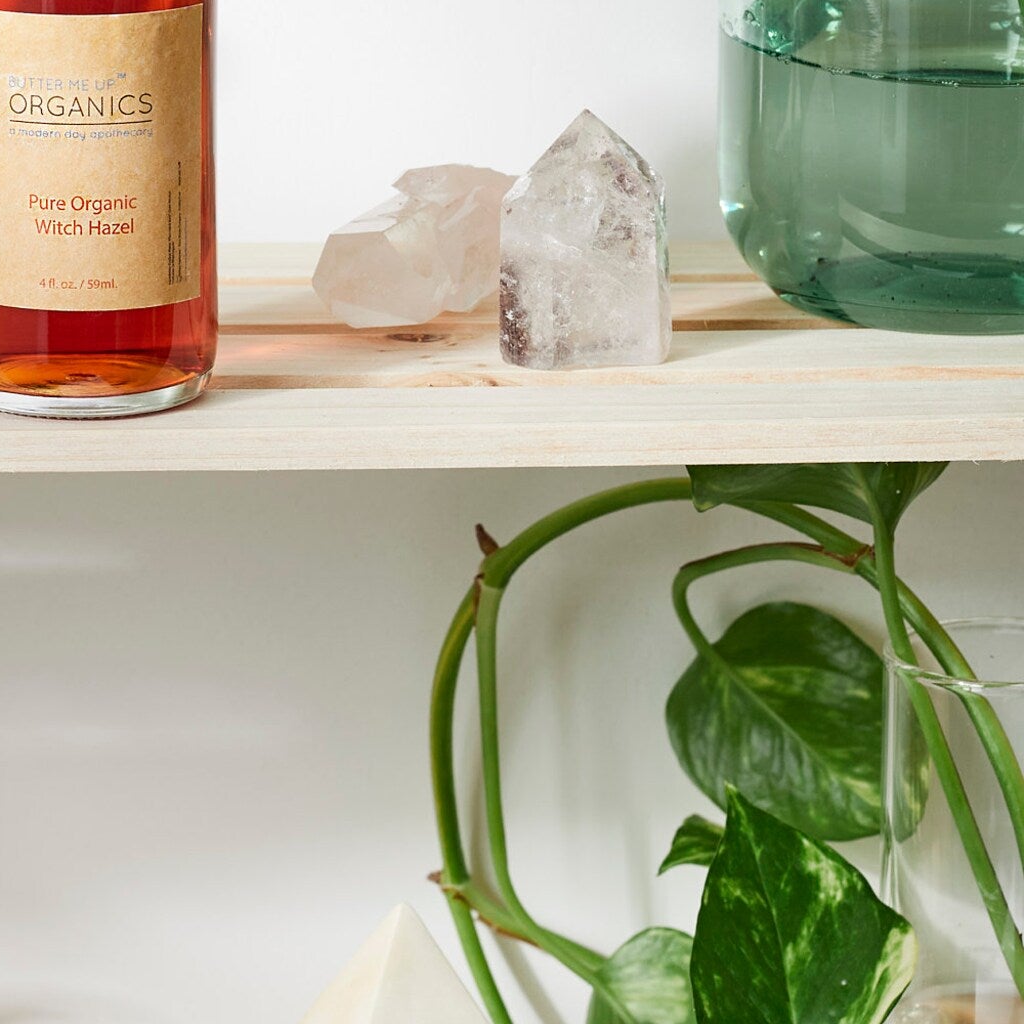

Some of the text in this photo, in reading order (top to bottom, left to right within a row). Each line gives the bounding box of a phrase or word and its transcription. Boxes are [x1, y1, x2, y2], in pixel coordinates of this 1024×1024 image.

[8, 75, 63, 90] BUTTER
[68, 78, 89, 91] ME
[9, 93, 153, 117] ORGANICS
[9, 126, 154, 141] a modern day apothecary
[29, 194, 138, 215] Pure Organic
[35, 218, 135, 236] Witch Hazel
[39, 279, 46, 289] 4
[61, 282, 78, 290] oz.
[79, 280, 85, 290] /
